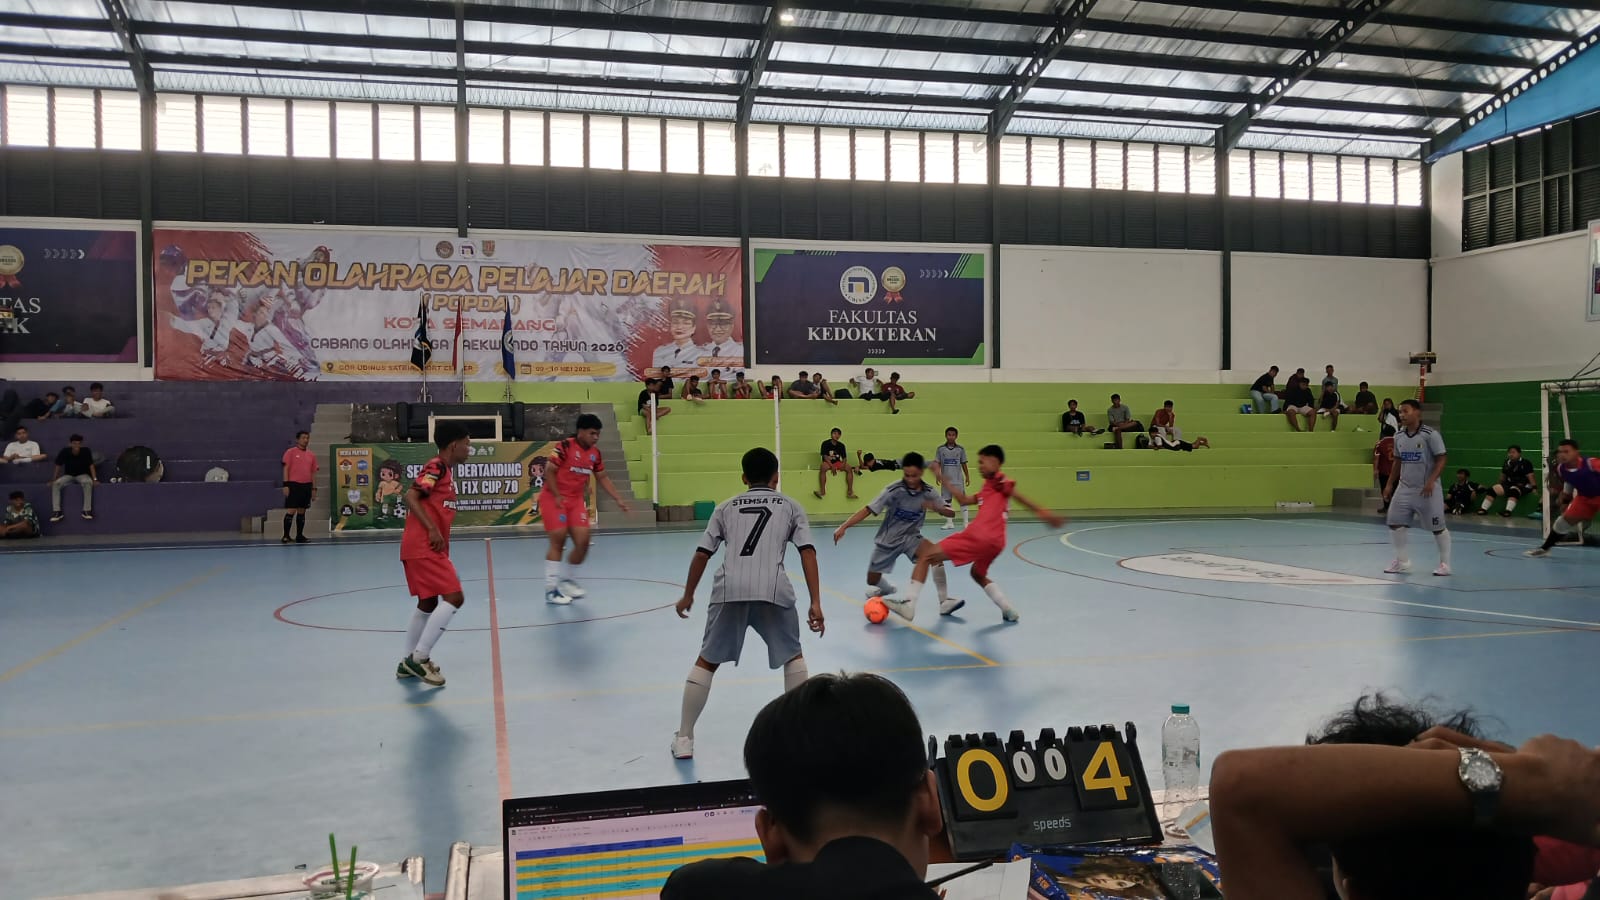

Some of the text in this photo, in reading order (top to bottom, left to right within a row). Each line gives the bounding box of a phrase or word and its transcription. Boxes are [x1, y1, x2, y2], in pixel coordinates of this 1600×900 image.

[186, 258, 728, 297] PEKAN OLAHRAGA PELAJAR DAERAH
[443, 318, 556, 331] SEMAANG
[829, 310, 918, 325] FAKULTAS
[807, 327, 937, 342] KEDOKTERAN
[311, 338, 624, 352] CABANG OLAHGA AEKWNDO TAHUN 2026
[457, 463, 522, 478] BERTANDING
[462, 481, 479, 494] FIX
[482, 480, 502, 494] CUP
[505, 480, 519, 493] 7.0
[732, 498, 768, 506] STEMSA
[739, 506, 772, 556] 7
[957, 741, 1132, 812] 0 0 0 4
[1033, 816, 1072, 833] speeds
